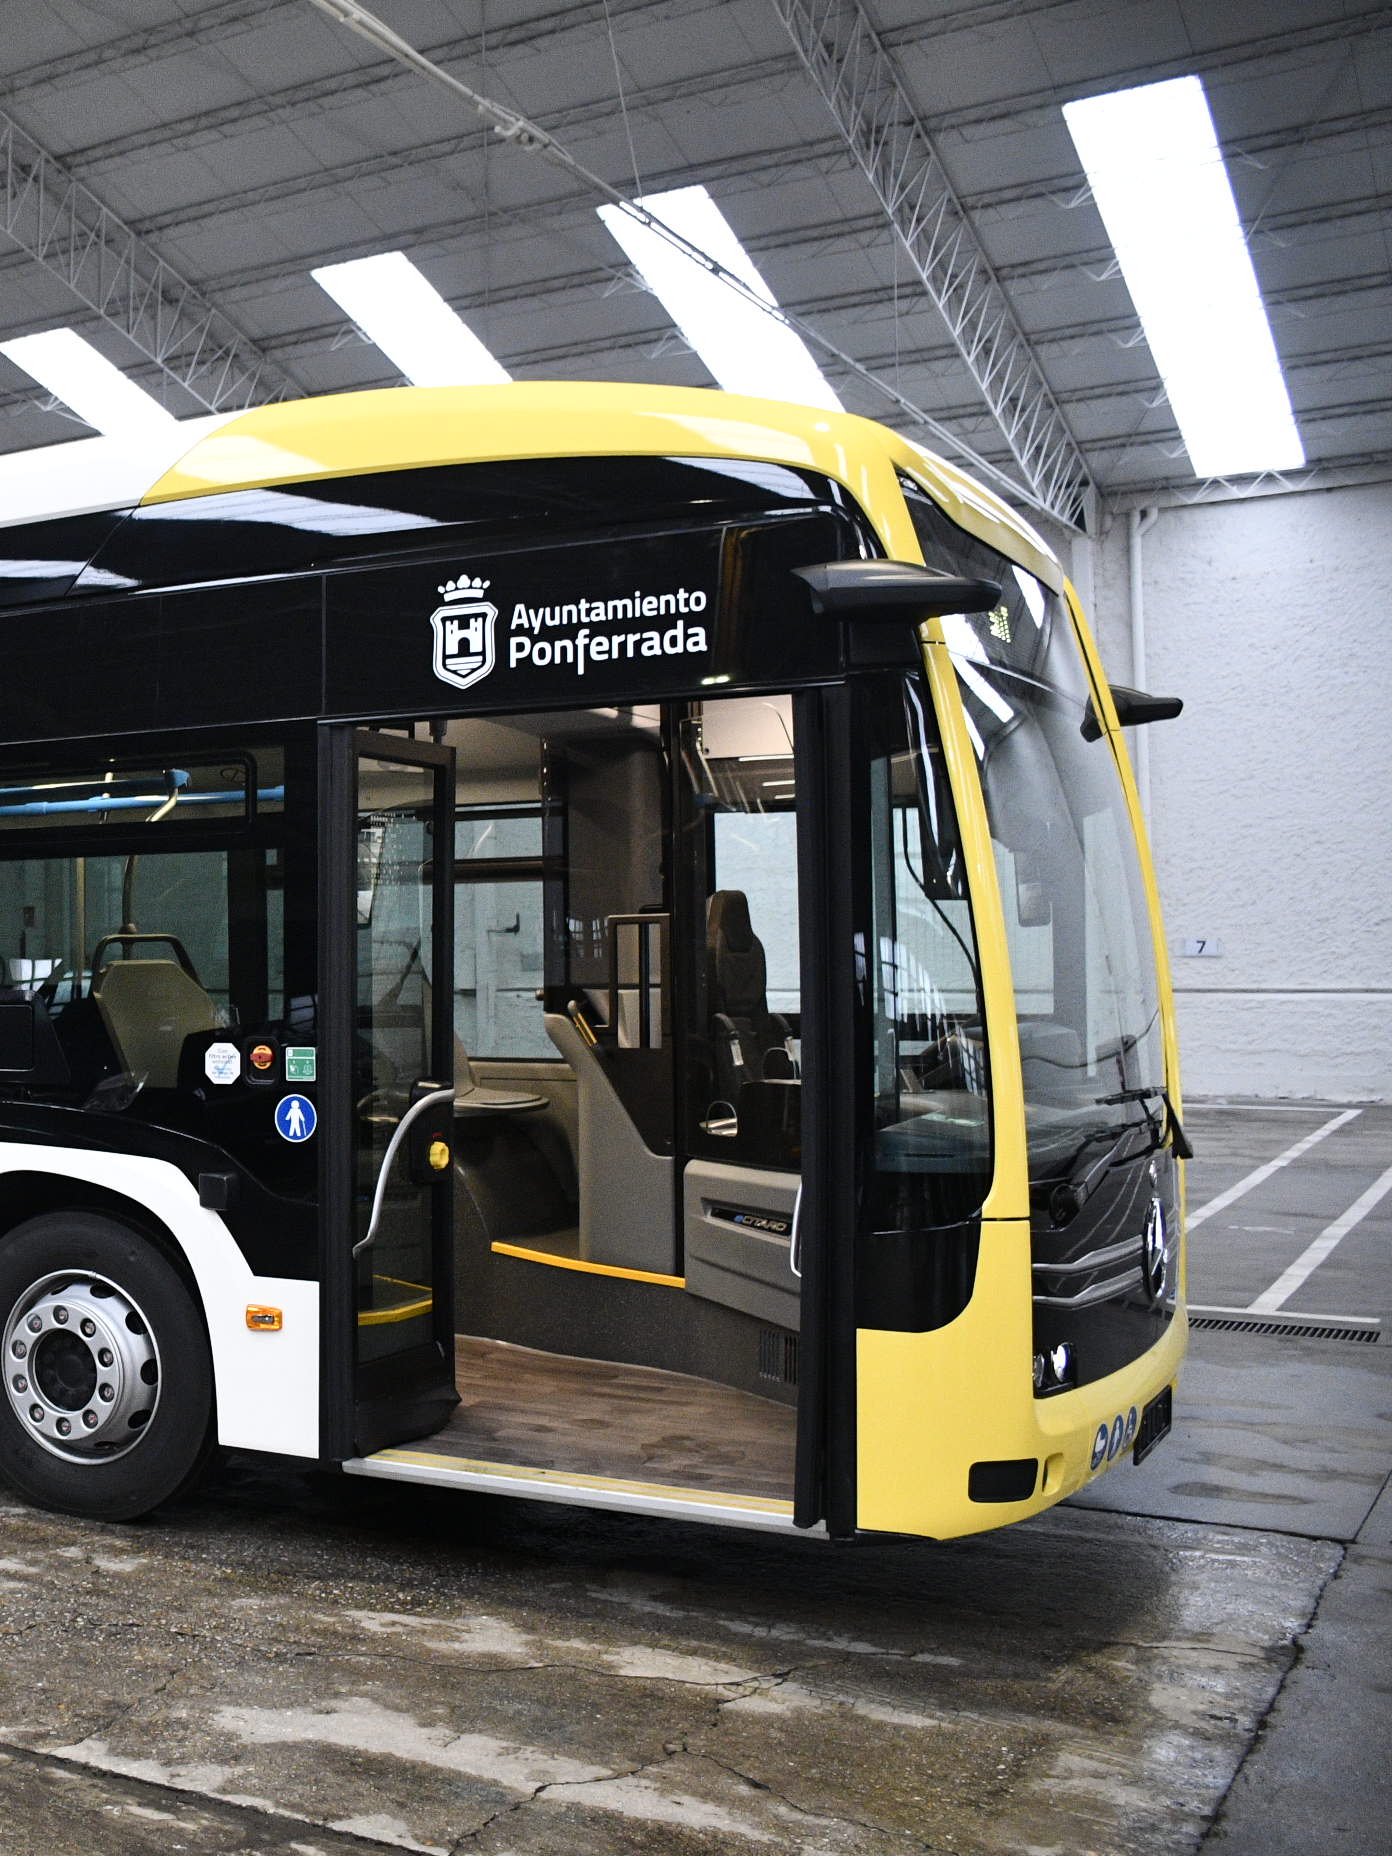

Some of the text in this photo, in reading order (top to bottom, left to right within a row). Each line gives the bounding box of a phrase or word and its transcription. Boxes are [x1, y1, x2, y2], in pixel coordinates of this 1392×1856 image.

[510, 588, 707, 635] Ayuntamiento
[509, 620, 708, 675] Ponferrada
[1196, 940, 1207, 954] 7
